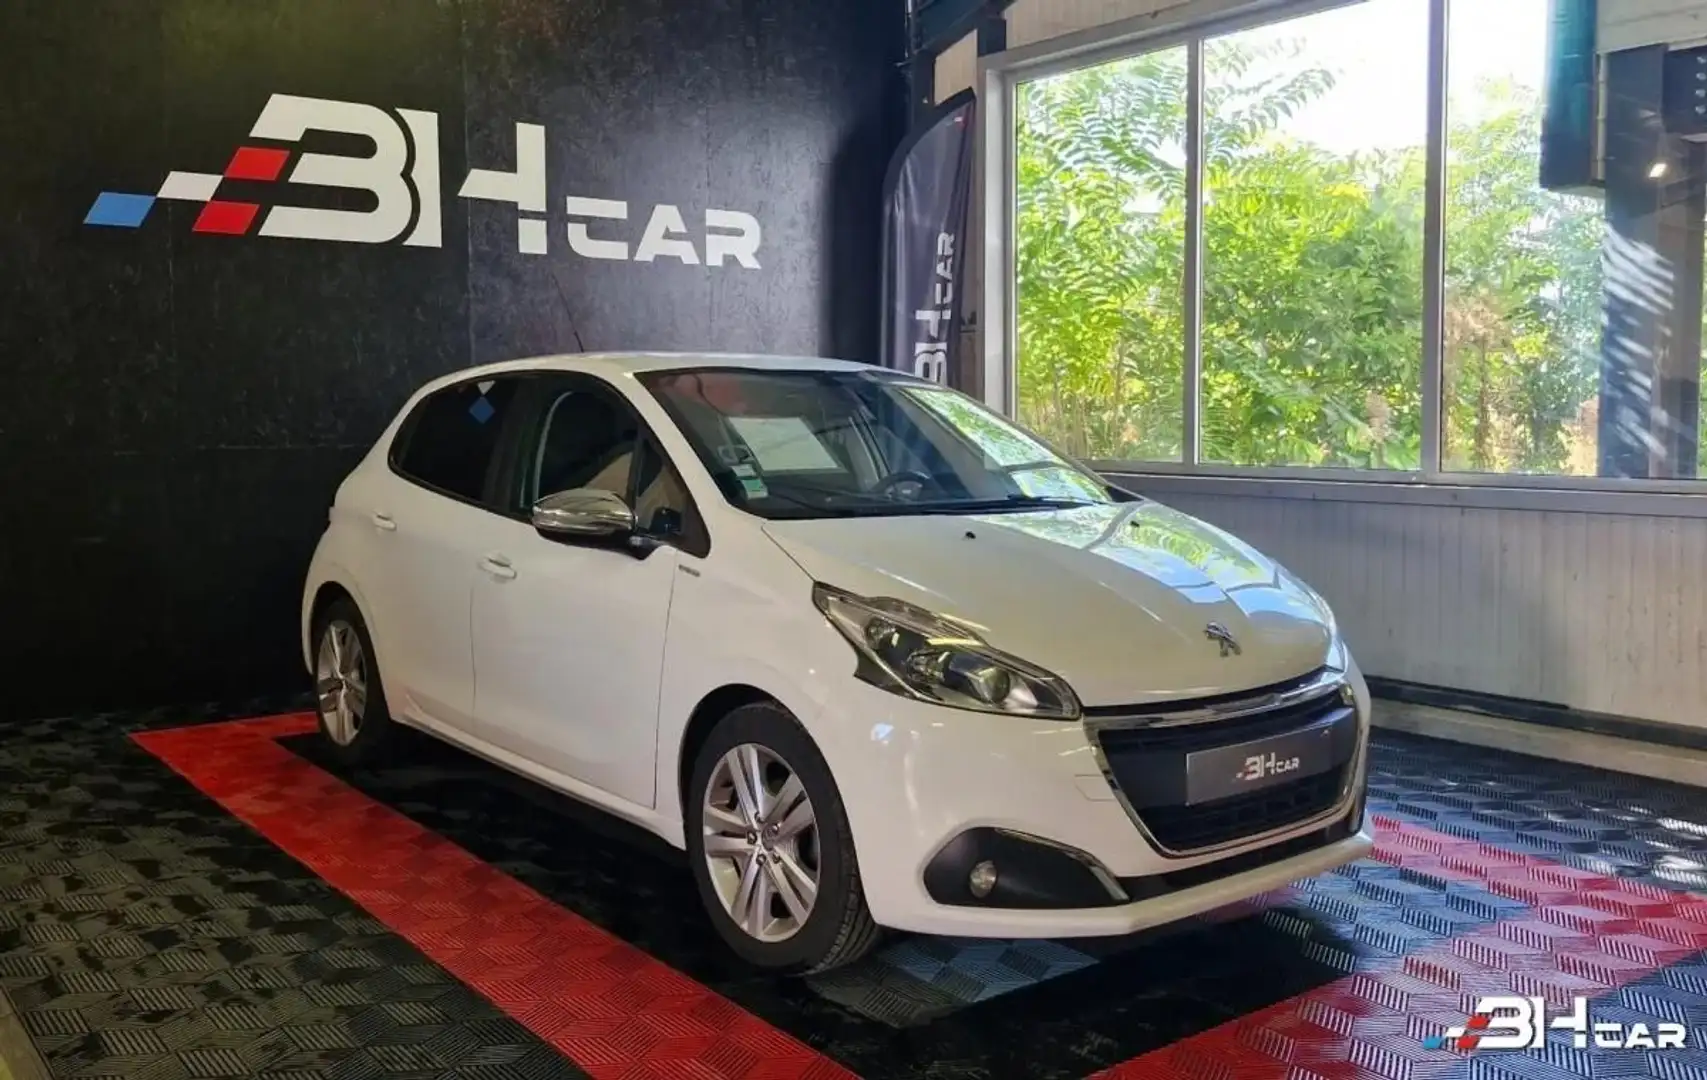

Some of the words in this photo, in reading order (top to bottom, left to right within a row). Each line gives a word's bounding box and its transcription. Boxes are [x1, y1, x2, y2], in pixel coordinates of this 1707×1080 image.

[566, 196, 761, 270] CAR
[935, 231, 955, 305] CAR
[1277, 757, 1300, 773] CAR
